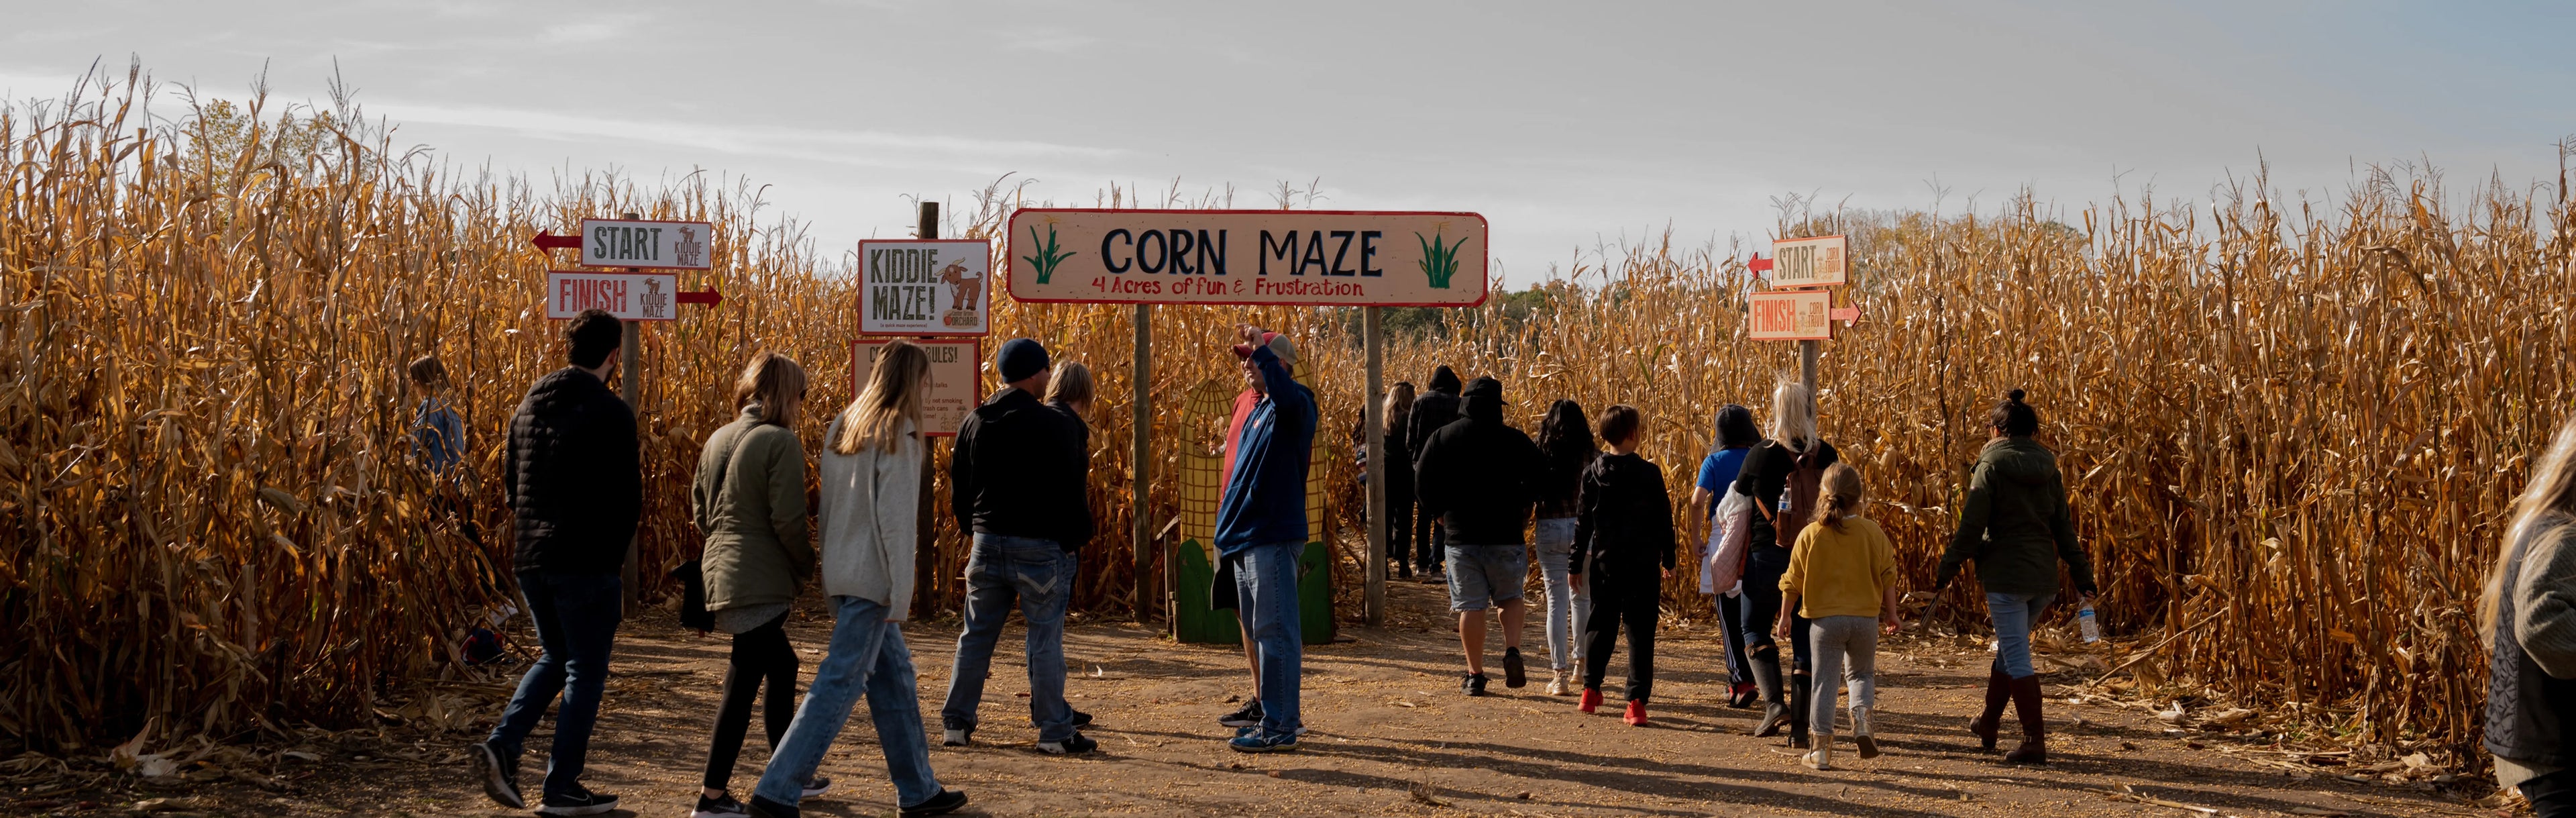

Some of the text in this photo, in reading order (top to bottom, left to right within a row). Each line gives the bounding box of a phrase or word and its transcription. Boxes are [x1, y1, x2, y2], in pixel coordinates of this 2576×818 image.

[594, 226, 661, 260] START
[674, 241, 702, 254] KIDDIE
[677, 253, 699, 266] MAZE
[1101, 228, 1383, 277] CORN MAZE
[1826, 246, 1839, 260] CORN
[871, 249, 938, 283] KIDDIE
[1779, 245, 1817, 280] START
[1825, 259, 1841, 274] TRIVIA
[1091, 276, 1364, 296] 4 Acres of fun & Frustration
[559, 278, 627, 312] FINISH
[640, 293, 667, 306] KIDDIE
[873, 286, 935, 320] MAZE!
[643, 305, 664, 318] MAZE
[1754, 299, 1796, 332] FINISH
[1809, 301, 1823, 315] CORN
[952, 316, 977, 326] ORCHARD
[1808, 314, 1825, 327] TRIVIA
[926, 346, 958, 363] RULES!
